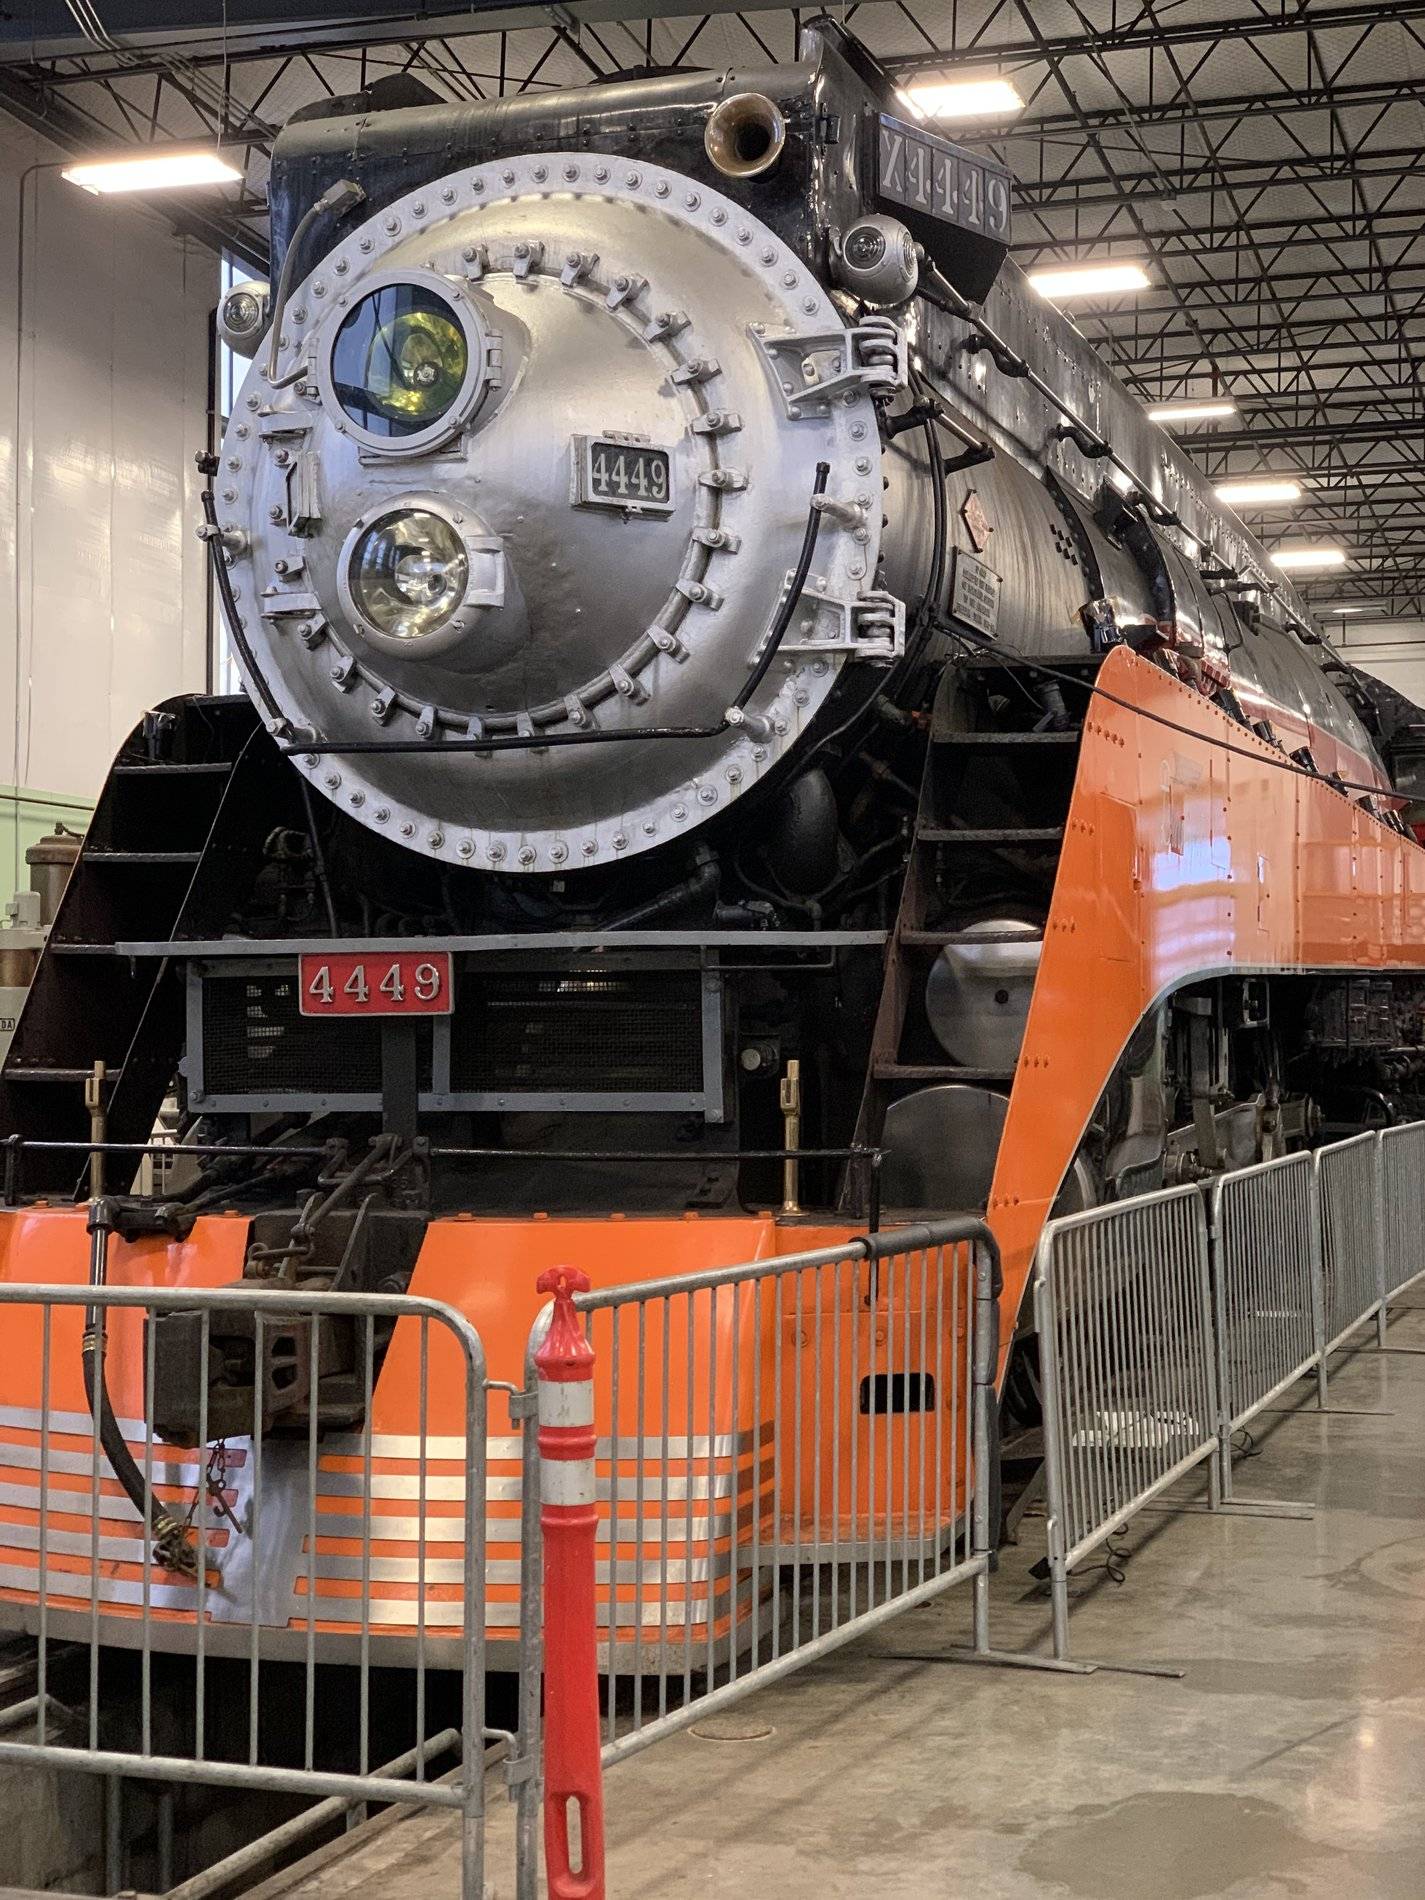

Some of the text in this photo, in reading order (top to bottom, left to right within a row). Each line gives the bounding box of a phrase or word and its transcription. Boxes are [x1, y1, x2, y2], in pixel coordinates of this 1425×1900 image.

[882, 129, 1007, 232] X4449
[592, 453, 667, 499] 4449
[309, 963, 440, 1003] 4449
